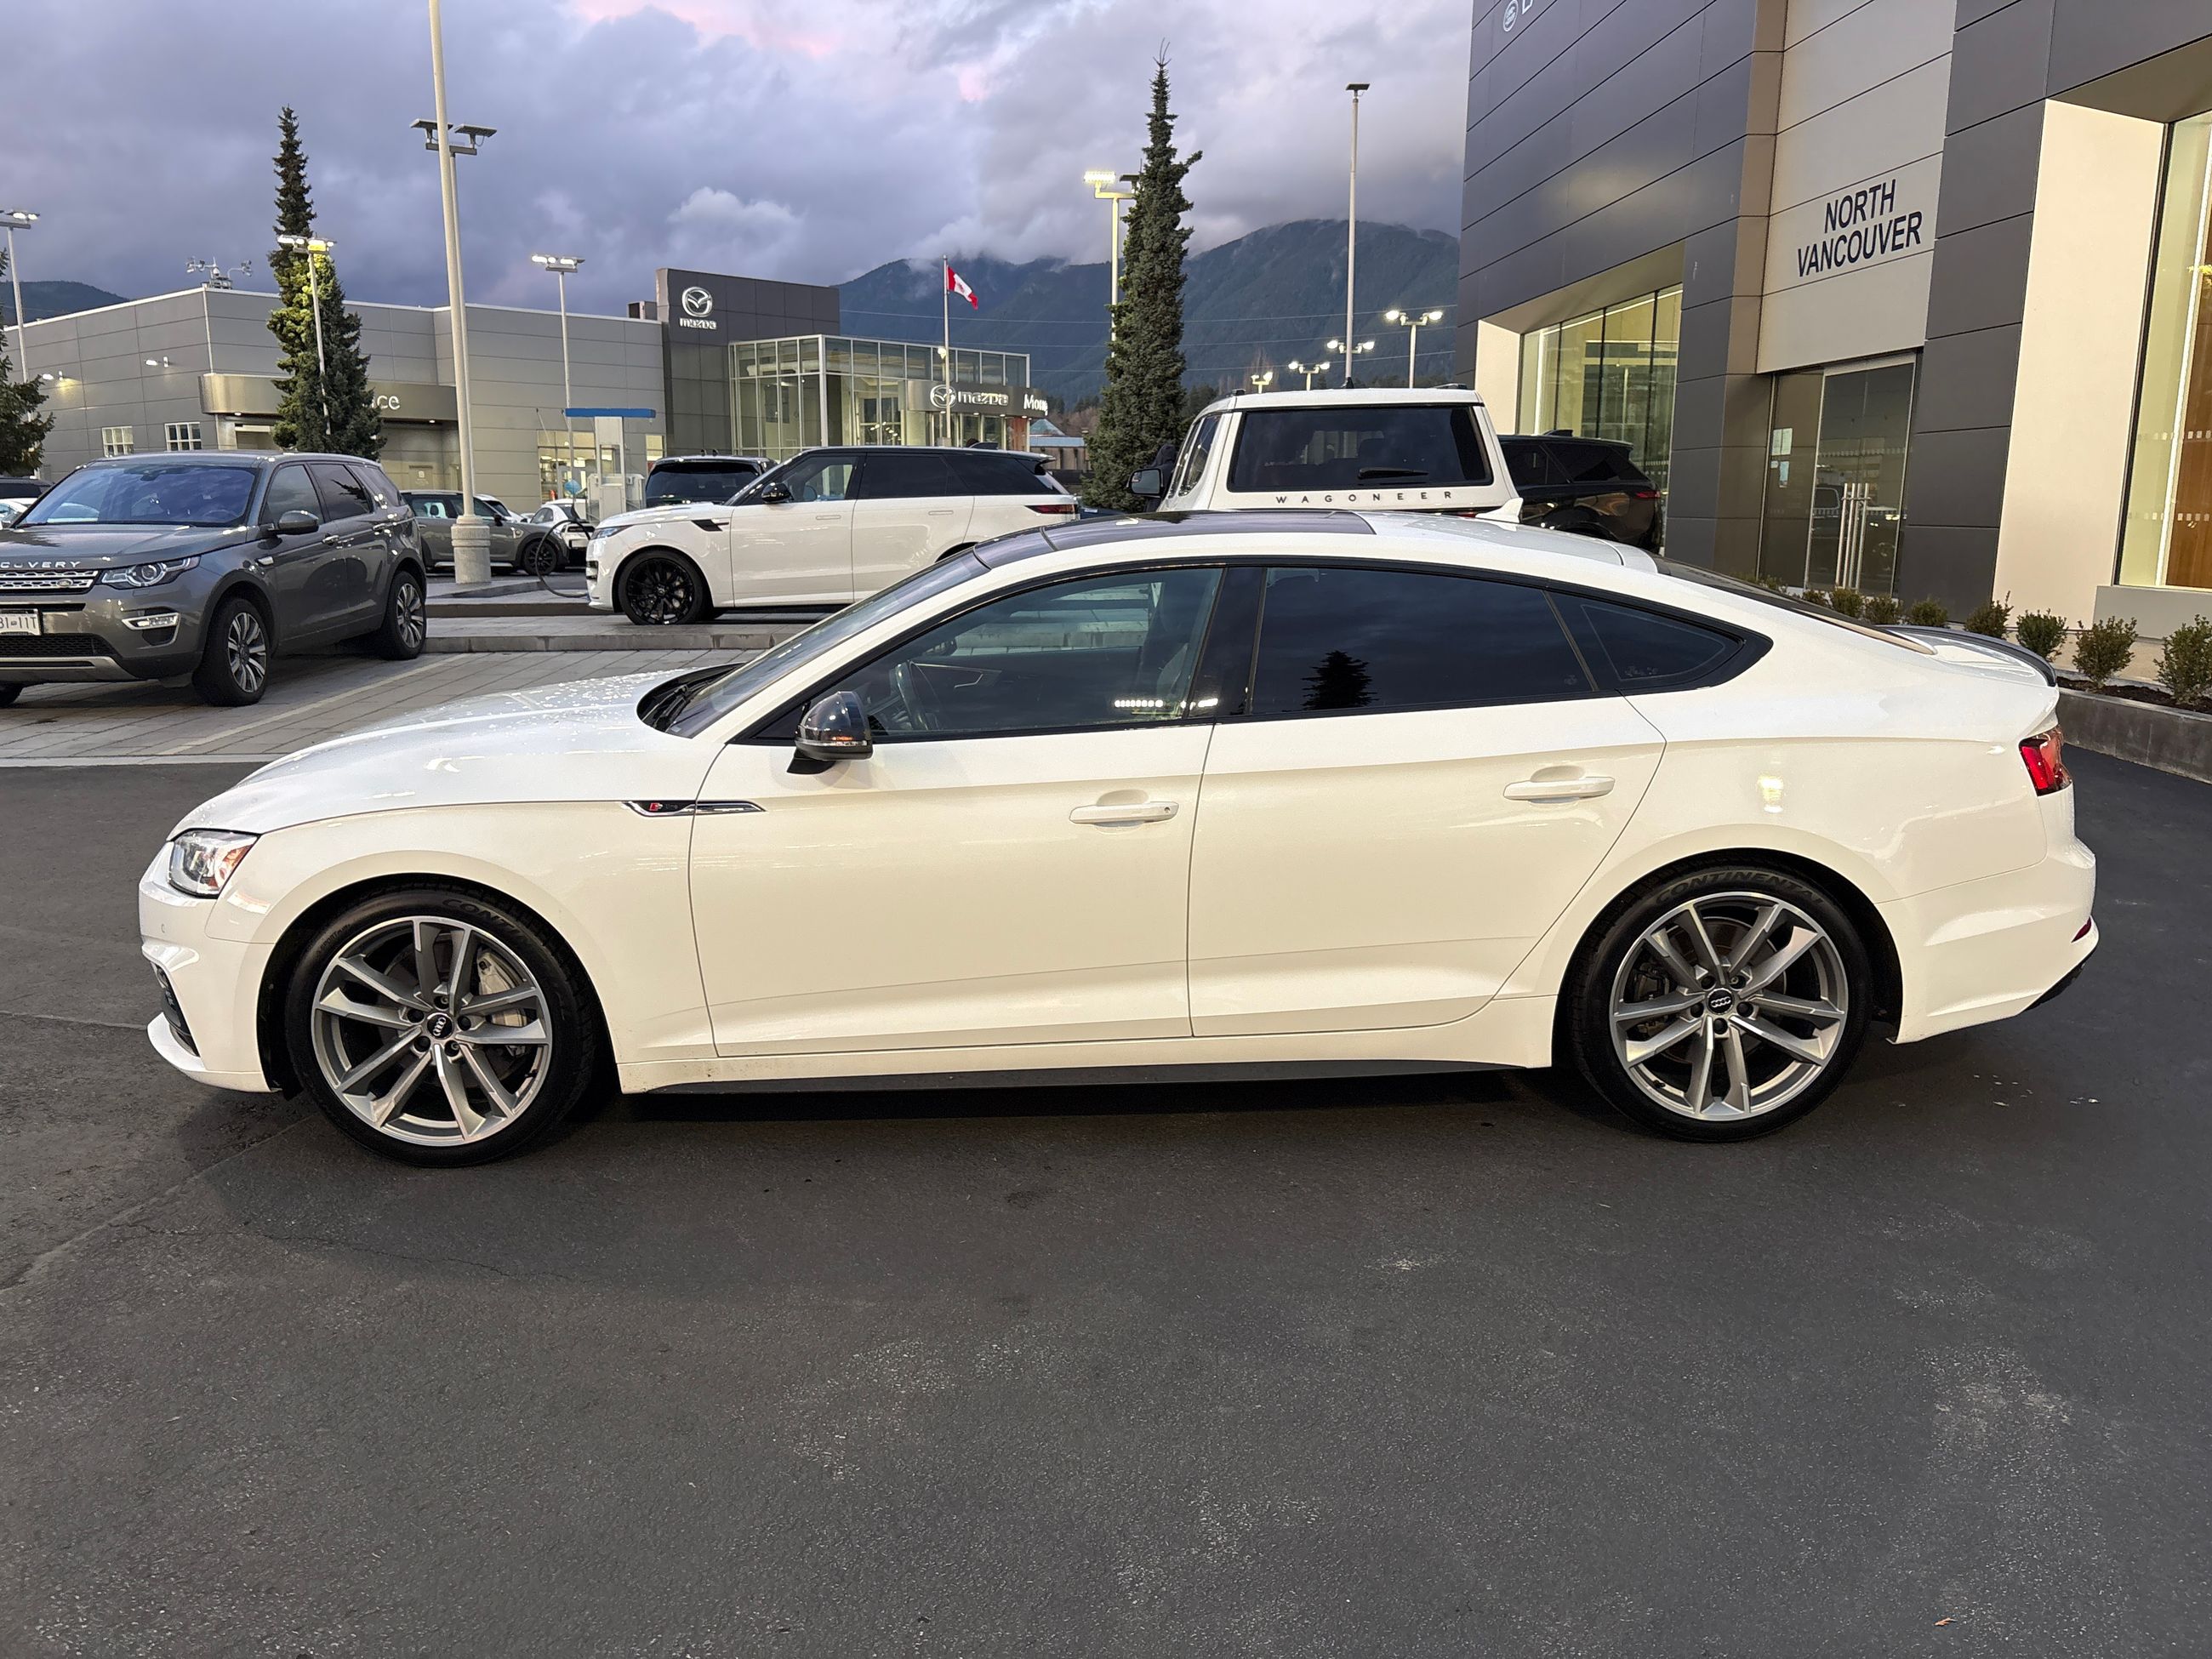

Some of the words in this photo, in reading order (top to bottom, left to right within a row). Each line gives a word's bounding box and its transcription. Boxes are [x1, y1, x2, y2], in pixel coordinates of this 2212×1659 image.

[1824, 178, 1896, 234] NORTH
[1797, 210, 1923, 277] VANCOUVER
[1275, 491, 1452, 504] WAGONEER
